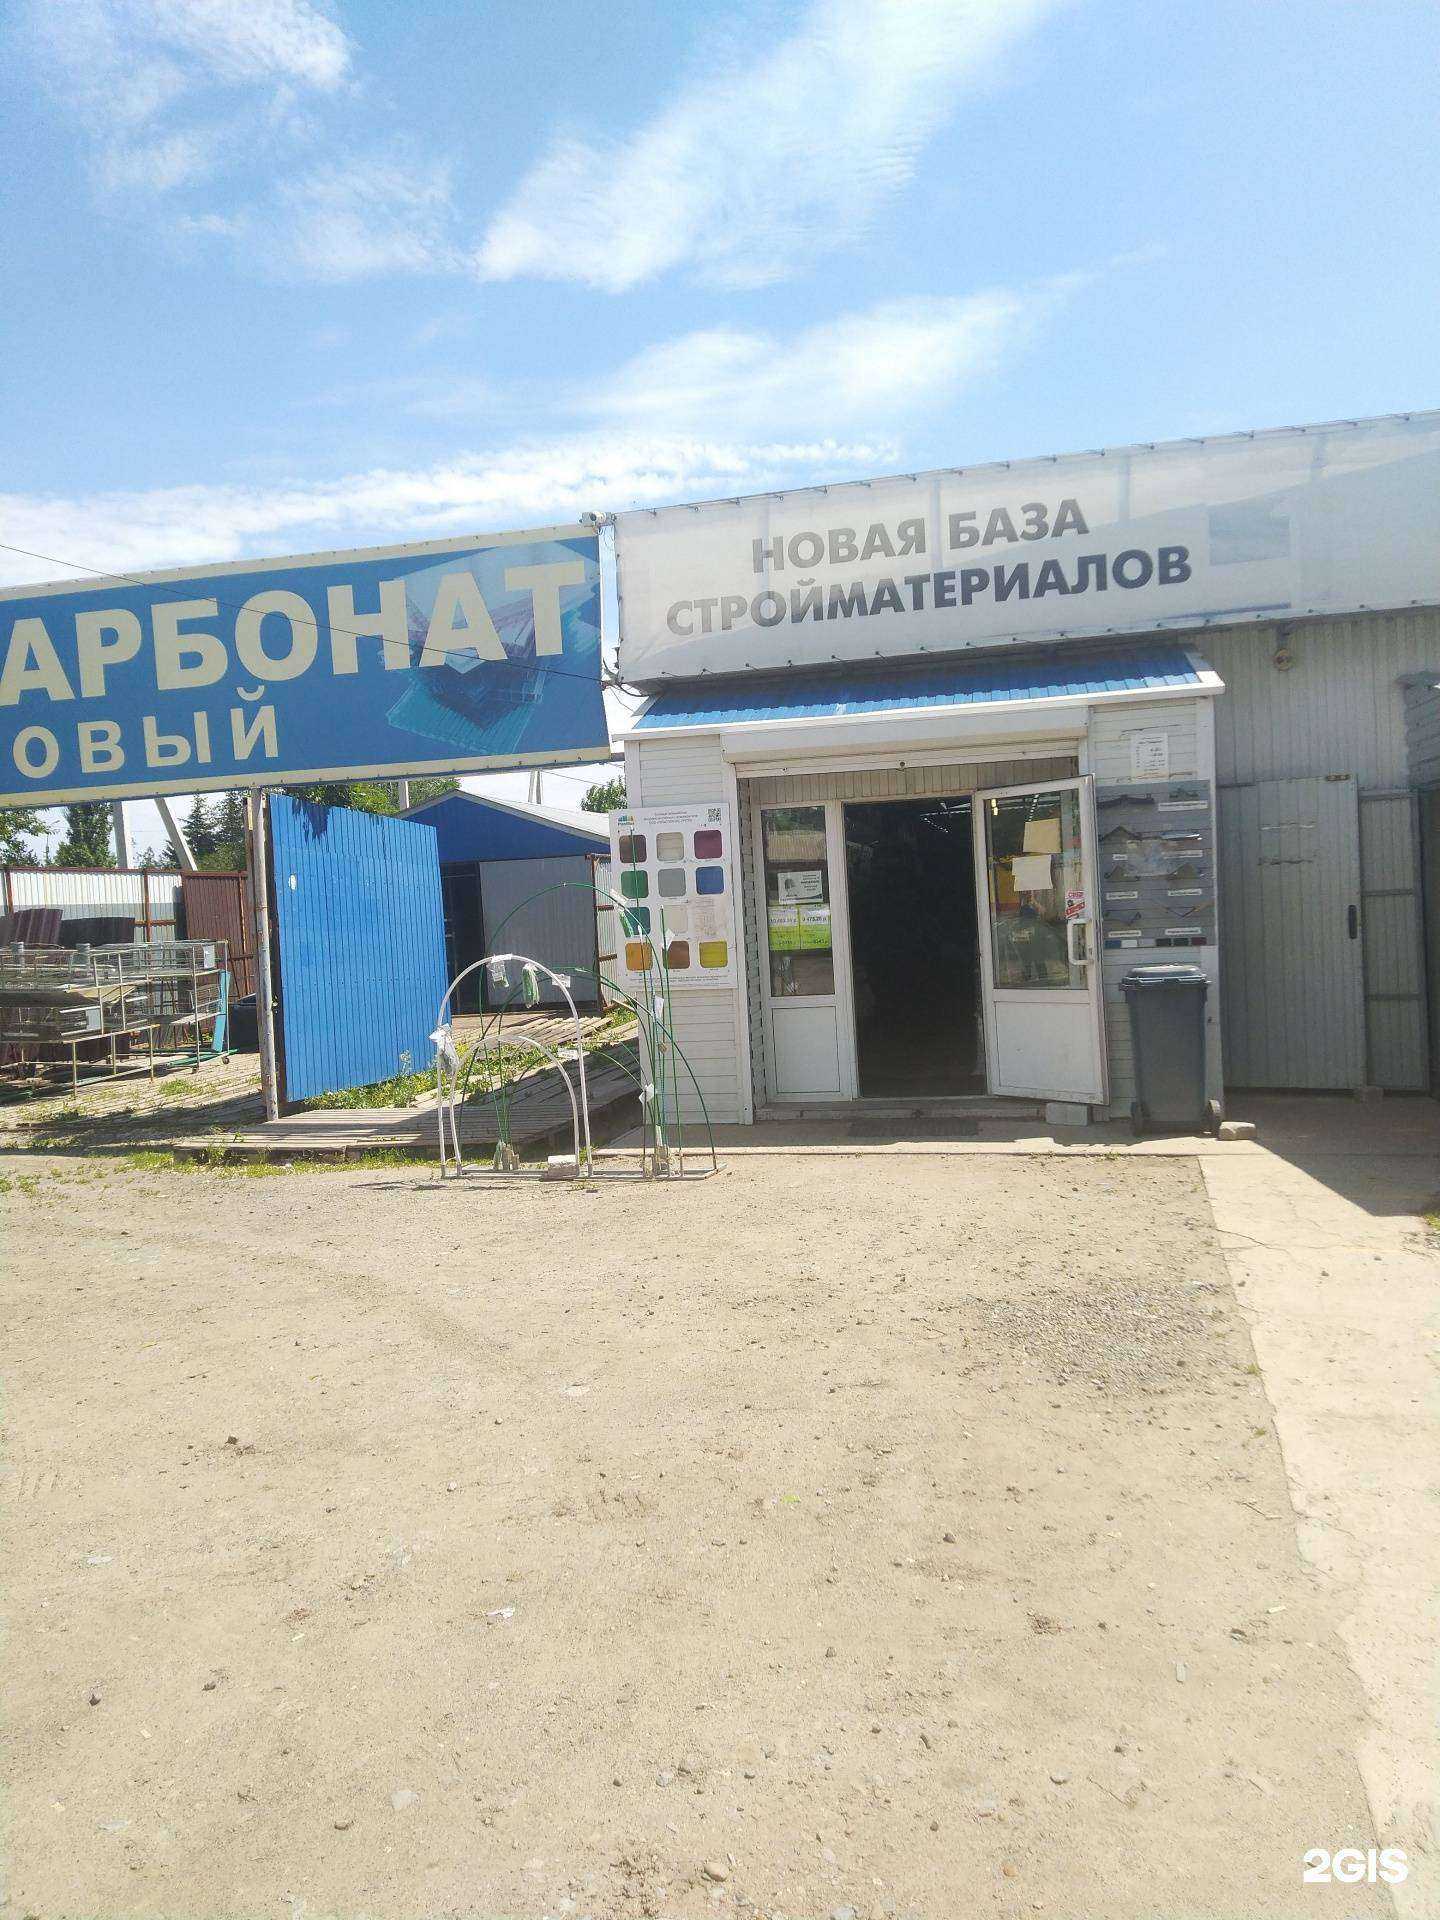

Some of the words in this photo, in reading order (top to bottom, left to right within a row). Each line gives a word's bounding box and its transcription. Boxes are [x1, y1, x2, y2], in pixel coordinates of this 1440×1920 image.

[752, 517, 928, 574] НОВАЯ
[948, 498, 1090, 551] БАЗА
[0, 561, 585, 707] АРБОНАТ
[666, 545, 1193, 637] СТРОЙМАТЕРИАЛОВ
[12, 685, 279, 779] ОВЫЙ
